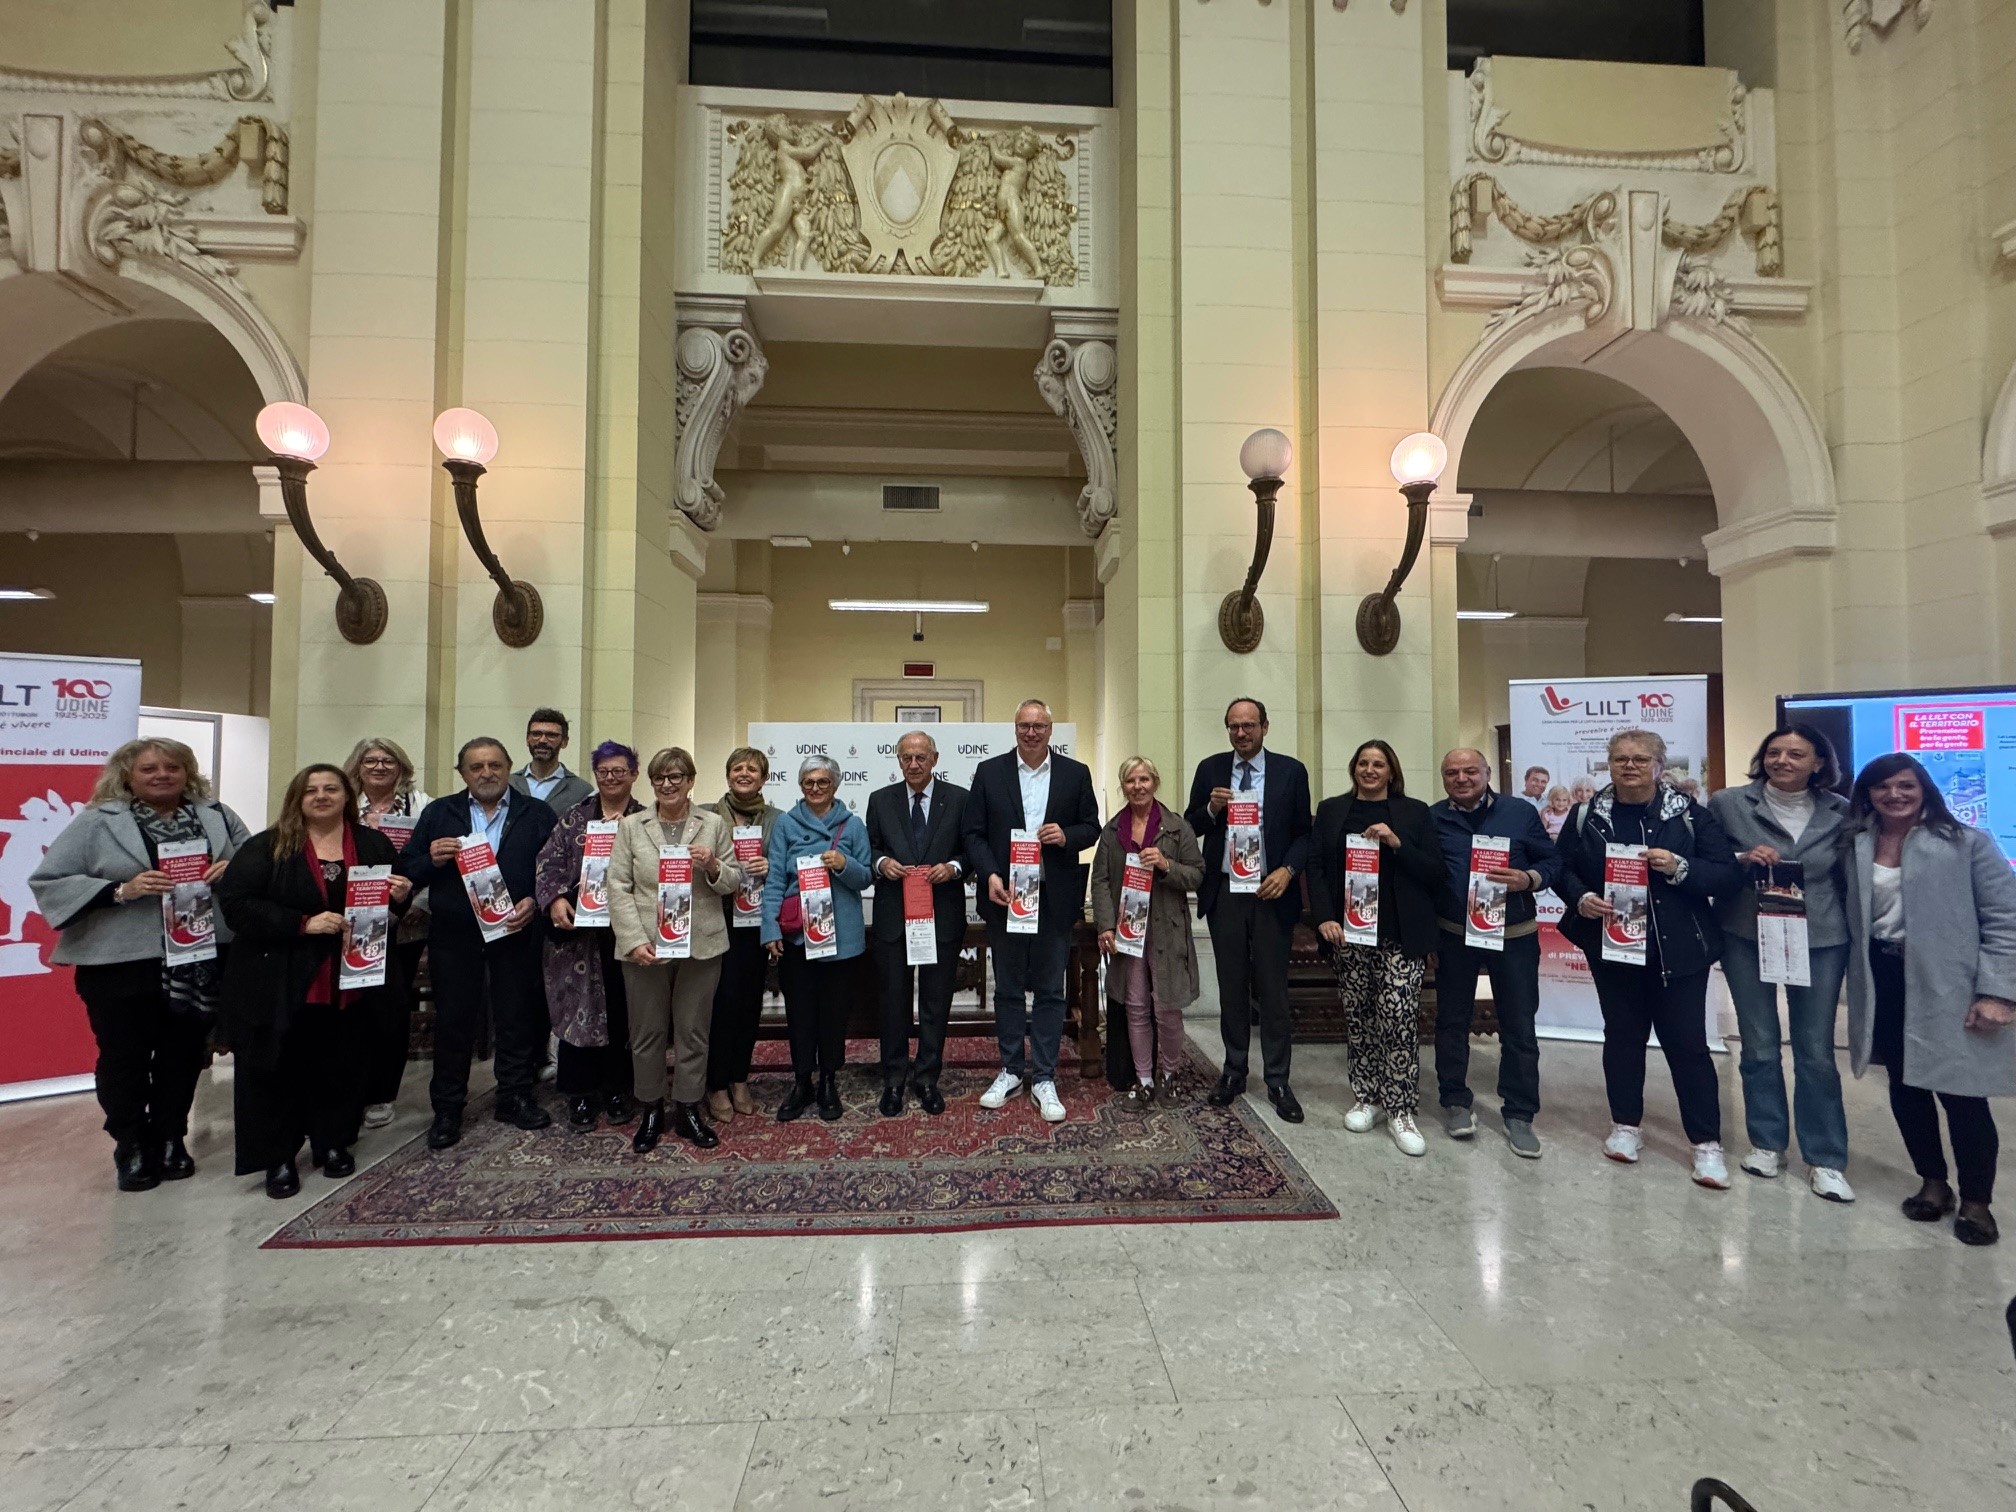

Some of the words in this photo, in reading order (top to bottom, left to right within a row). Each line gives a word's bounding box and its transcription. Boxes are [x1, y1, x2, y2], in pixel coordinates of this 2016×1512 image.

[52, 678, 112, 700] 100
[56, 698, 109, 713] UDINE
[1586, 700, 1632, 715] LILT
[1637, 693, 1674, 708] 100
[55, 711, 107, 720] 1925-2025
[1641, 708, 1673, 718] UDINE
[1920, 720, 1980, 728] TERRITORIO
[0, 748, 48, 756] inciale
[52, 748, 65, 756] di
[69, 748, 109, 757] Udine
[797, 744, 828, 754] UDINE
[958, 744, 989, 754] UDINE
